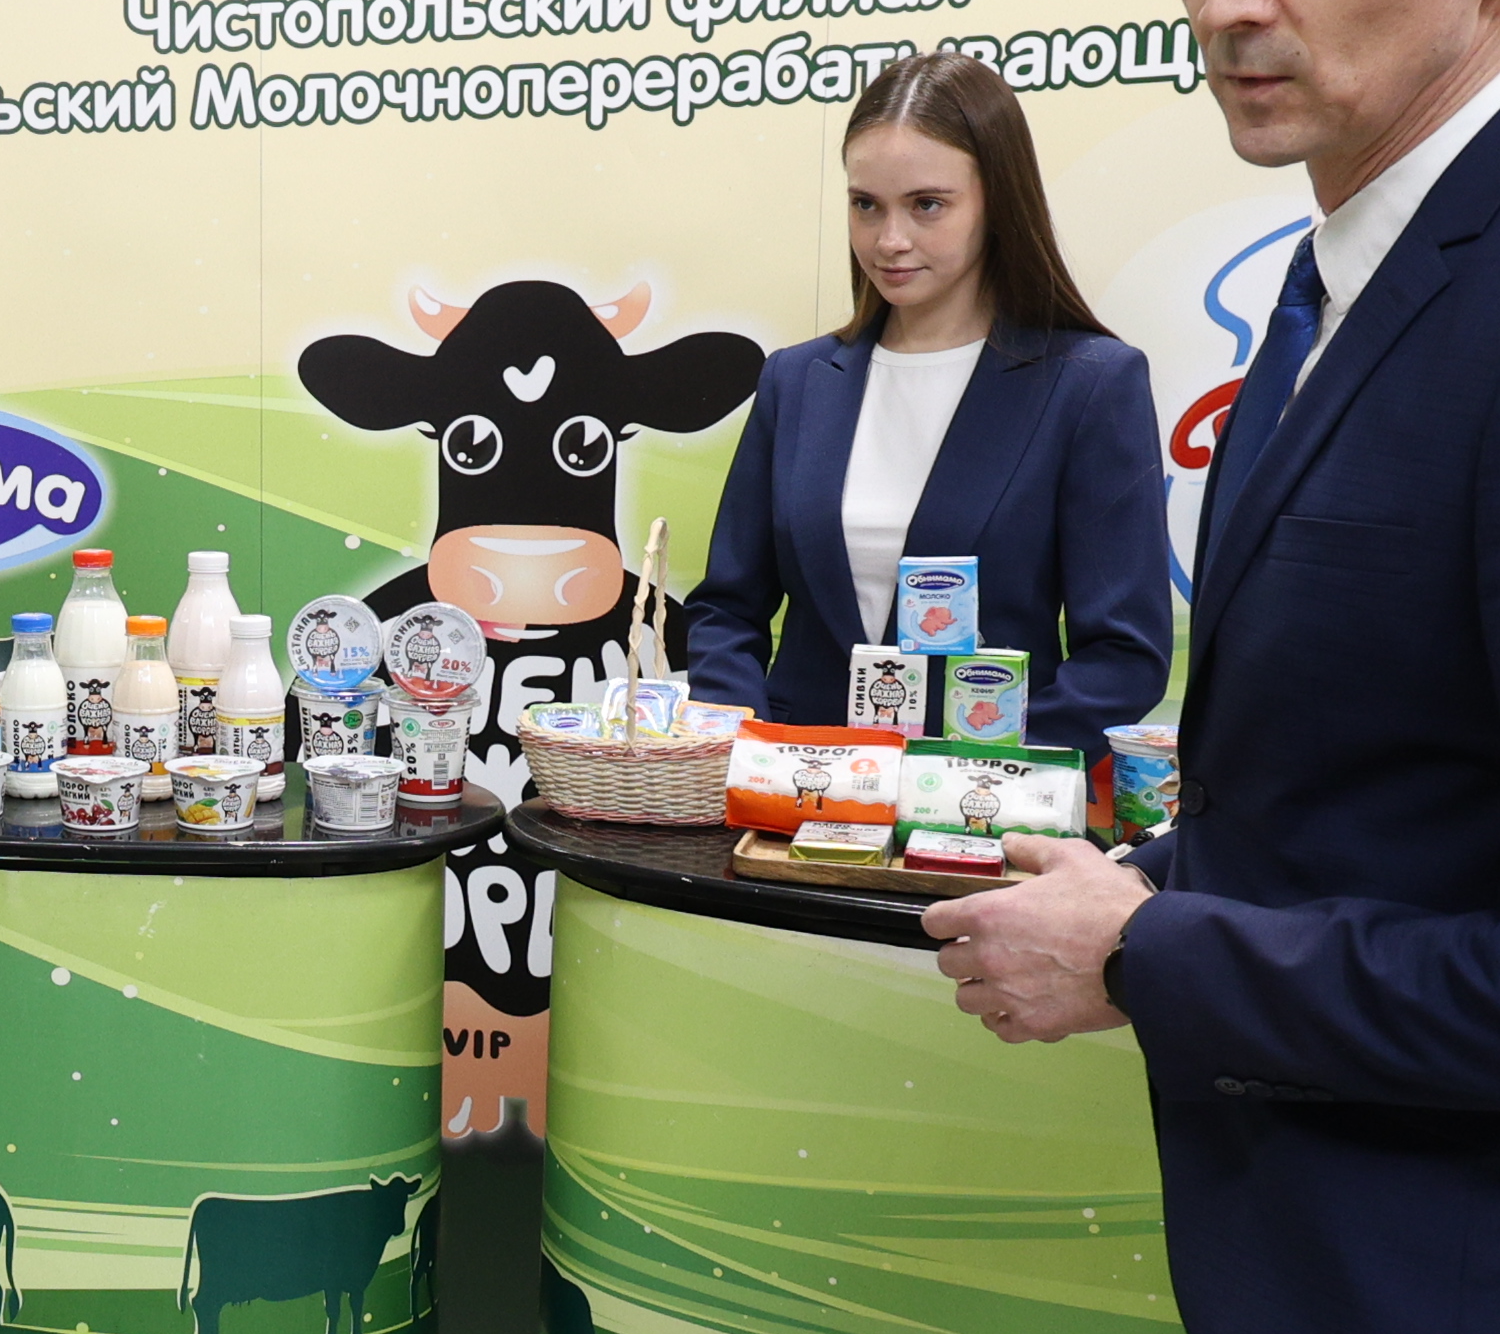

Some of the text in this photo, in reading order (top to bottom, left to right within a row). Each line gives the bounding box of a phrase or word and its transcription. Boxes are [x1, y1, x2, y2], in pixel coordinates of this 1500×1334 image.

[343, 646, 370, 658] 15%
[441, 658, 472, 673] 20%
[855, 668, 867, 716] СЛИВКИ
[870, 689, 905, 698] ВАЖНАЯ
[81, 701, 109, 710] ОЧЕНЬ
[909, 690, 917, 710] 10%
[66, 680, 77, 748] МОЛОКО
[79, 708, 111, 717] ВАЖНАЯ
[347, 734, 359, 754] 5%
[776, 745, 859, 757] ТВОРОГ
[405, 743, 417, 776] 20%
[944, 757, 1032, 777] ТВОРОГ
[747, 776, 765, 784] 200
[914, 806, 931, 814] 200
[443, 1028, 511, 1059] VIP
